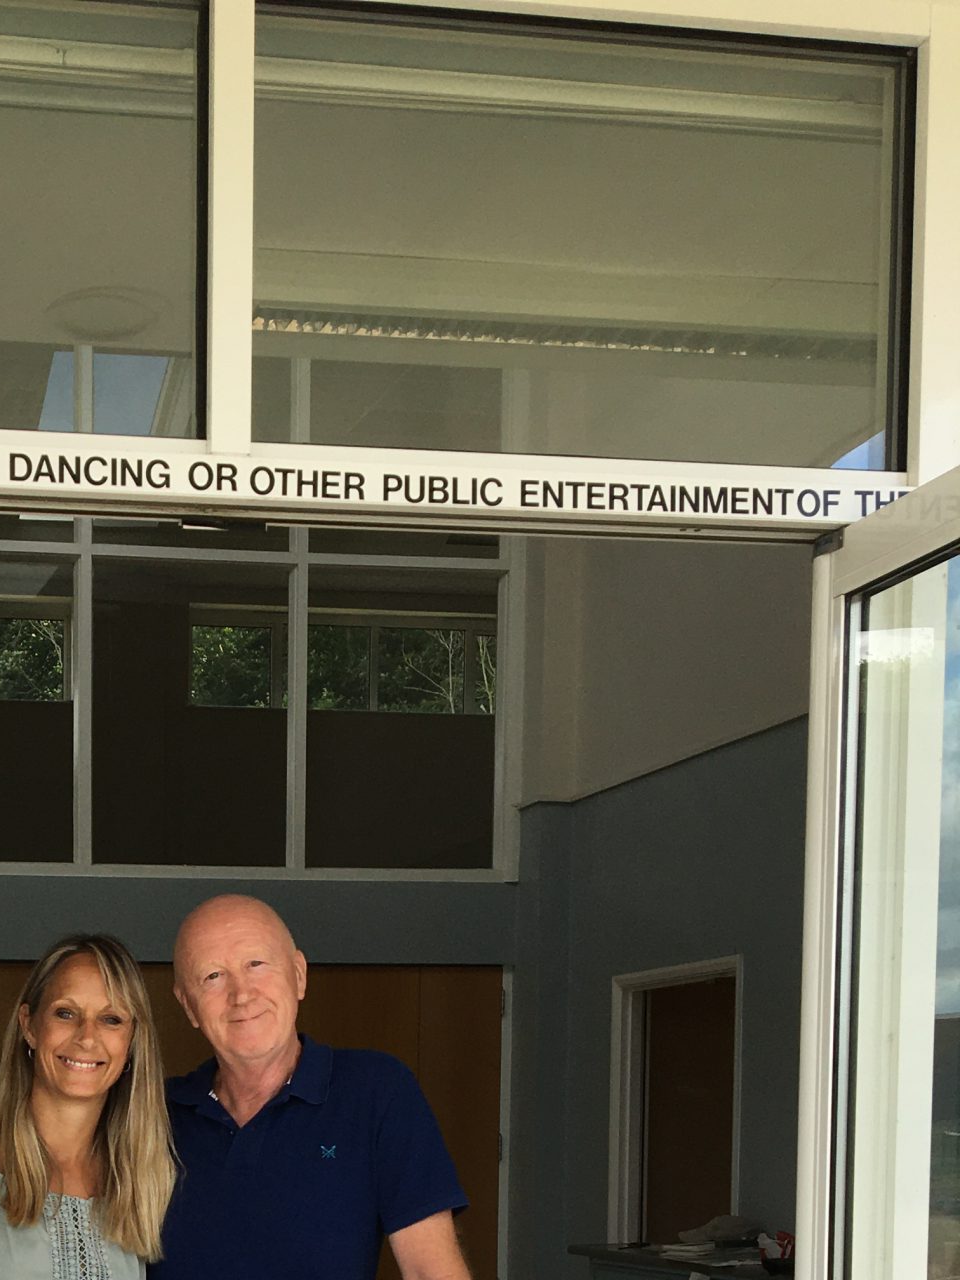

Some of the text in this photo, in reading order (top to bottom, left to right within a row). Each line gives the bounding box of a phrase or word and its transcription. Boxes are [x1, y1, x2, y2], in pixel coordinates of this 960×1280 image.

[9, 453, 171, 489] DANCING
[188, 461, 238, 491] OR
[249, 466, 365, 500] OTHER
[382, 473, 503, 506] PUBLIC
[520, 479, 794, 516] ENTERTAINMENT
[797, 488, 841, 517] OF
[854, 490, 911, 517] TH
